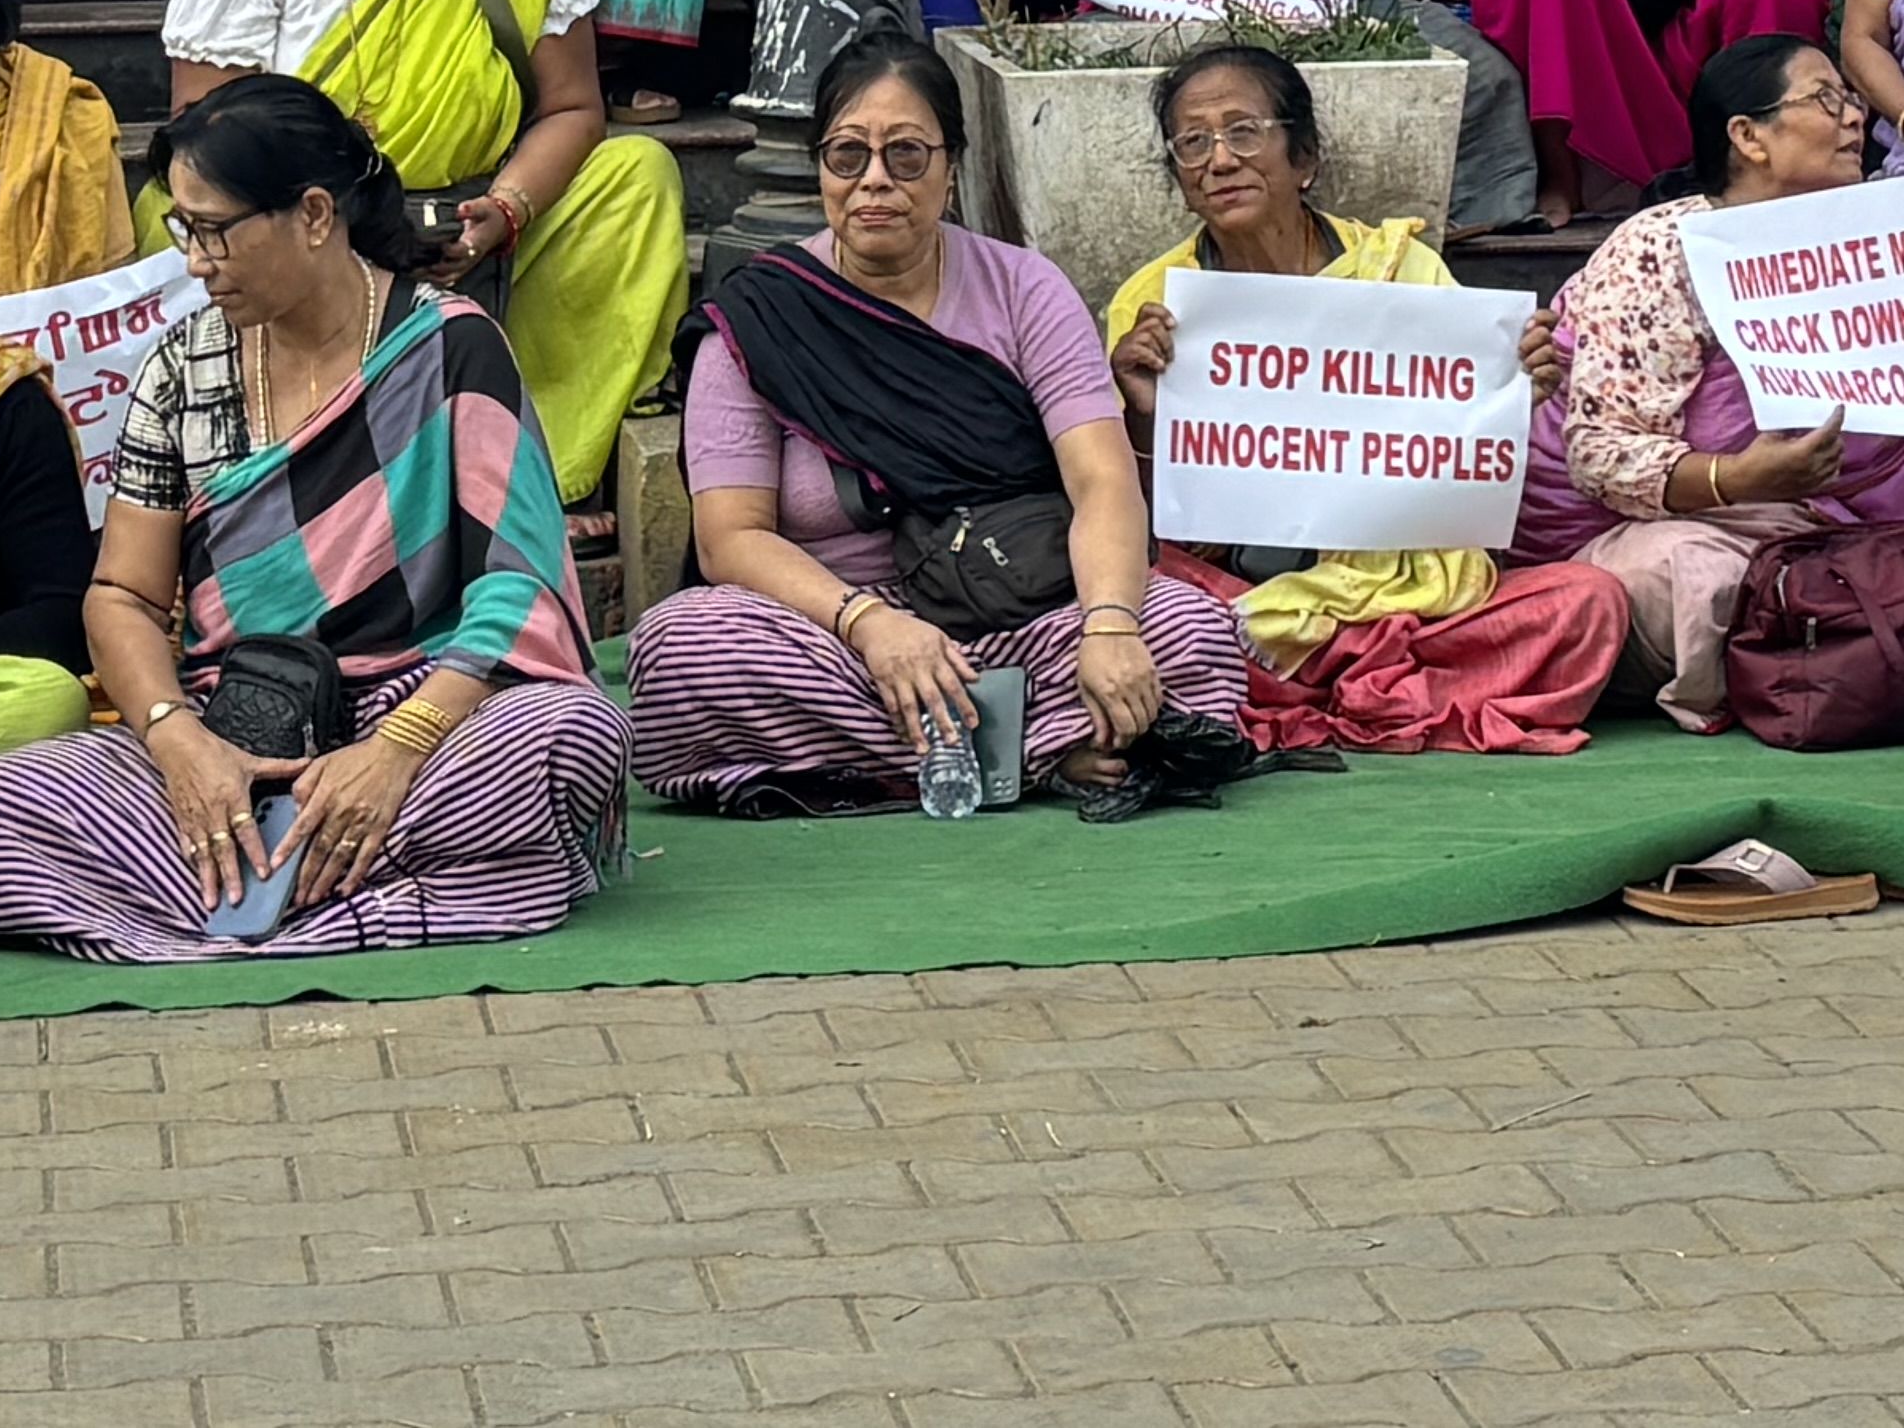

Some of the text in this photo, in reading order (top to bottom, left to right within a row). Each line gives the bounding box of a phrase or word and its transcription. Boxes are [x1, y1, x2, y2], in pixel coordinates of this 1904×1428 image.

[1725, 236, 1885, 302] IMMEDIATE
[1734, 302, 1831, 355] CRACK
[1209, 341, 1476, 402] STOP KILLING
[1749, 362, 1821, 399] KUKI
[1169, 419, 1516, 483] INNOCENT PEOPLES
